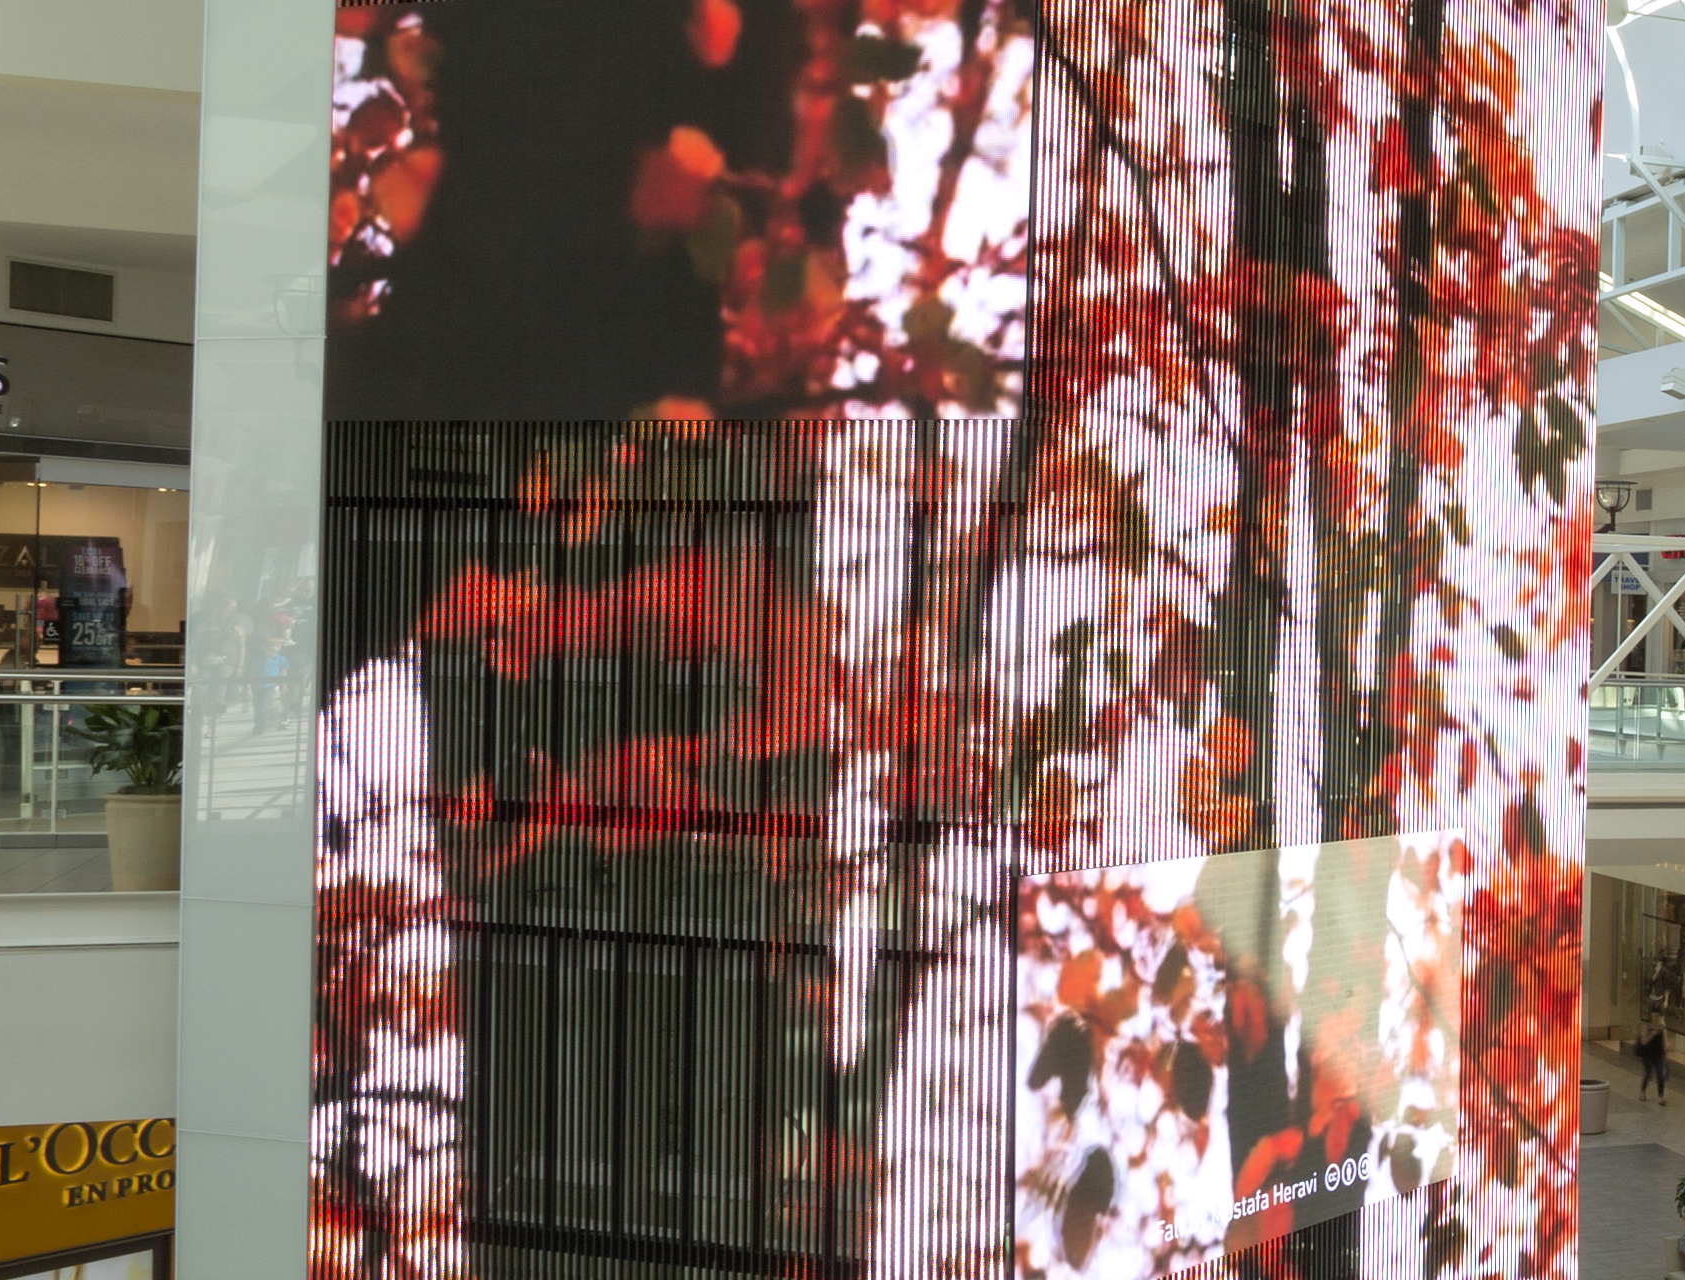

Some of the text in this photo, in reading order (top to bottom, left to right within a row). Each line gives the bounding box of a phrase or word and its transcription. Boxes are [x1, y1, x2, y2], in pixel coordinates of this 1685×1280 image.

[63, 1170, 176, 1207] EN PRO
[1272, 1172, 1318, 1207] Heravi
